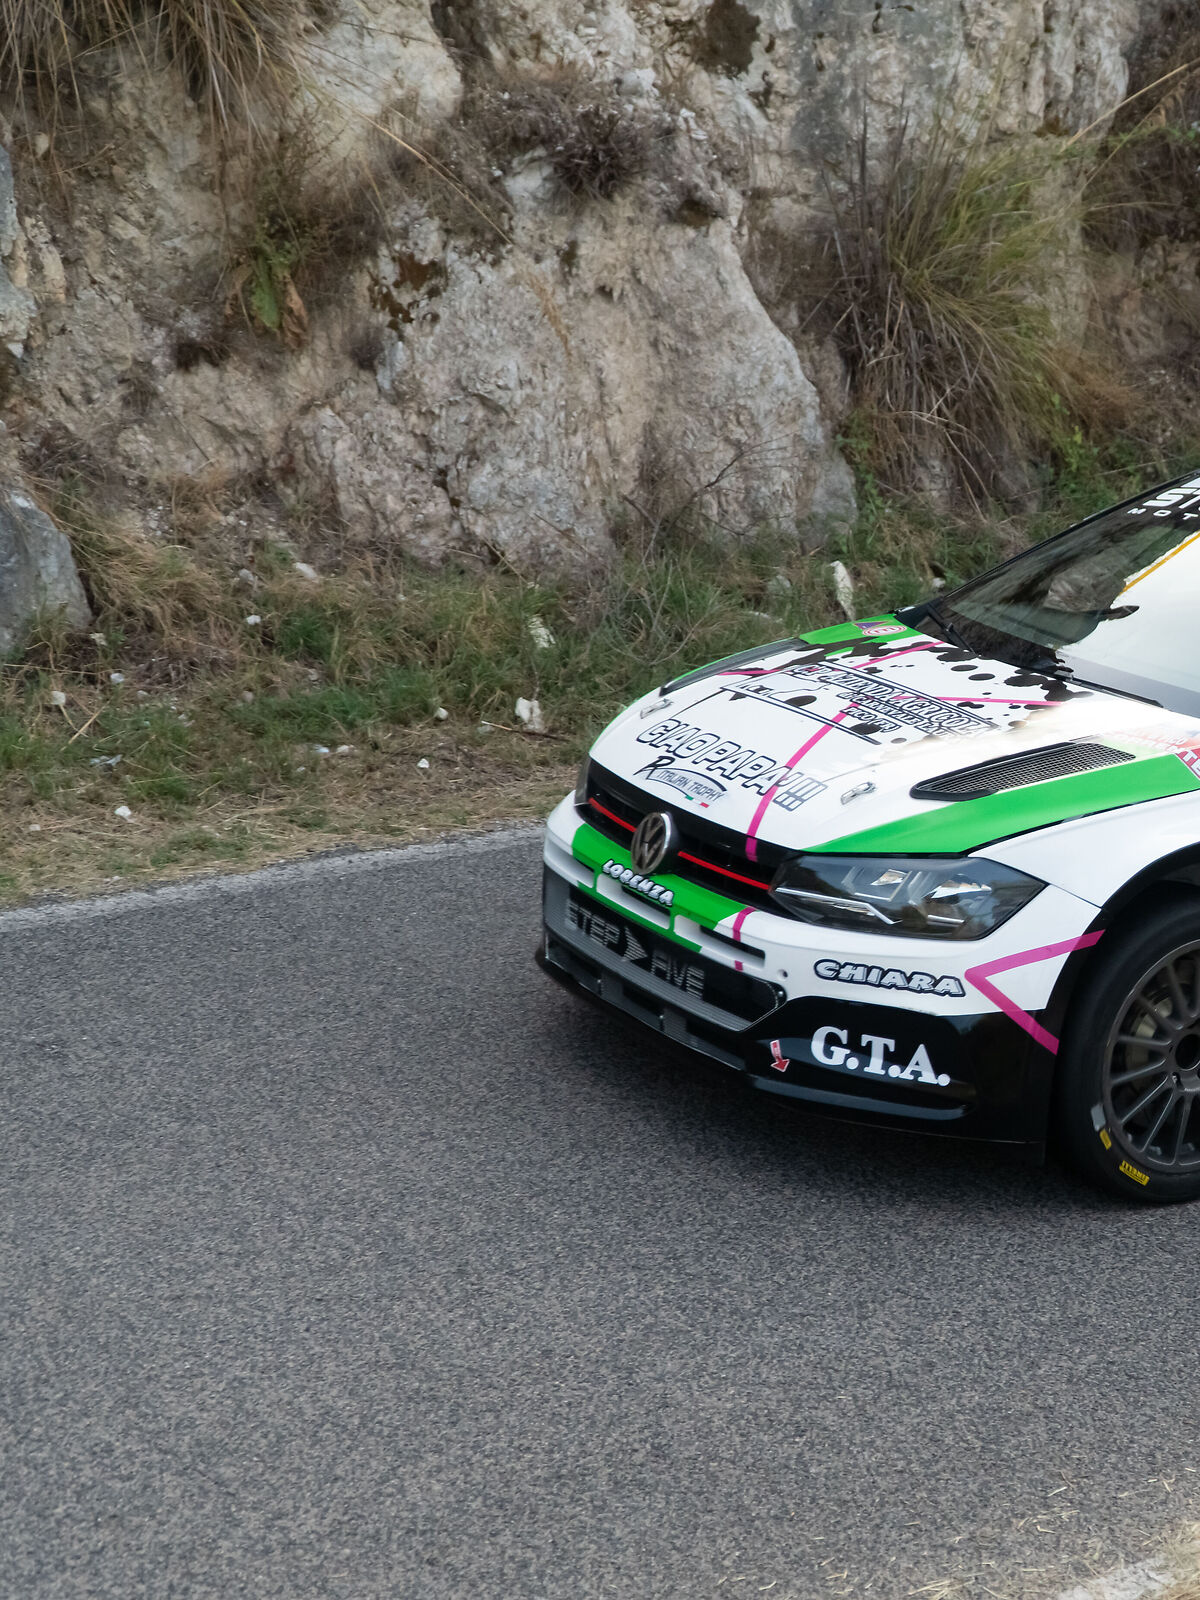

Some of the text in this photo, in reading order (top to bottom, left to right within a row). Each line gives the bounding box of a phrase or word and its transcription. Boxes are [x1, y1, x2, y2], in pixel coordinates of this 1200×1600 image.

[636, 718, 720, 758] CIAO
[657, 769, 725, 802] ITALIAN TROPHY
[601, 859, 675, 906] LORENZA
[814, 959, 966, 997] CHIARA
[811, 1025, 951, 1087] G.T.A.
